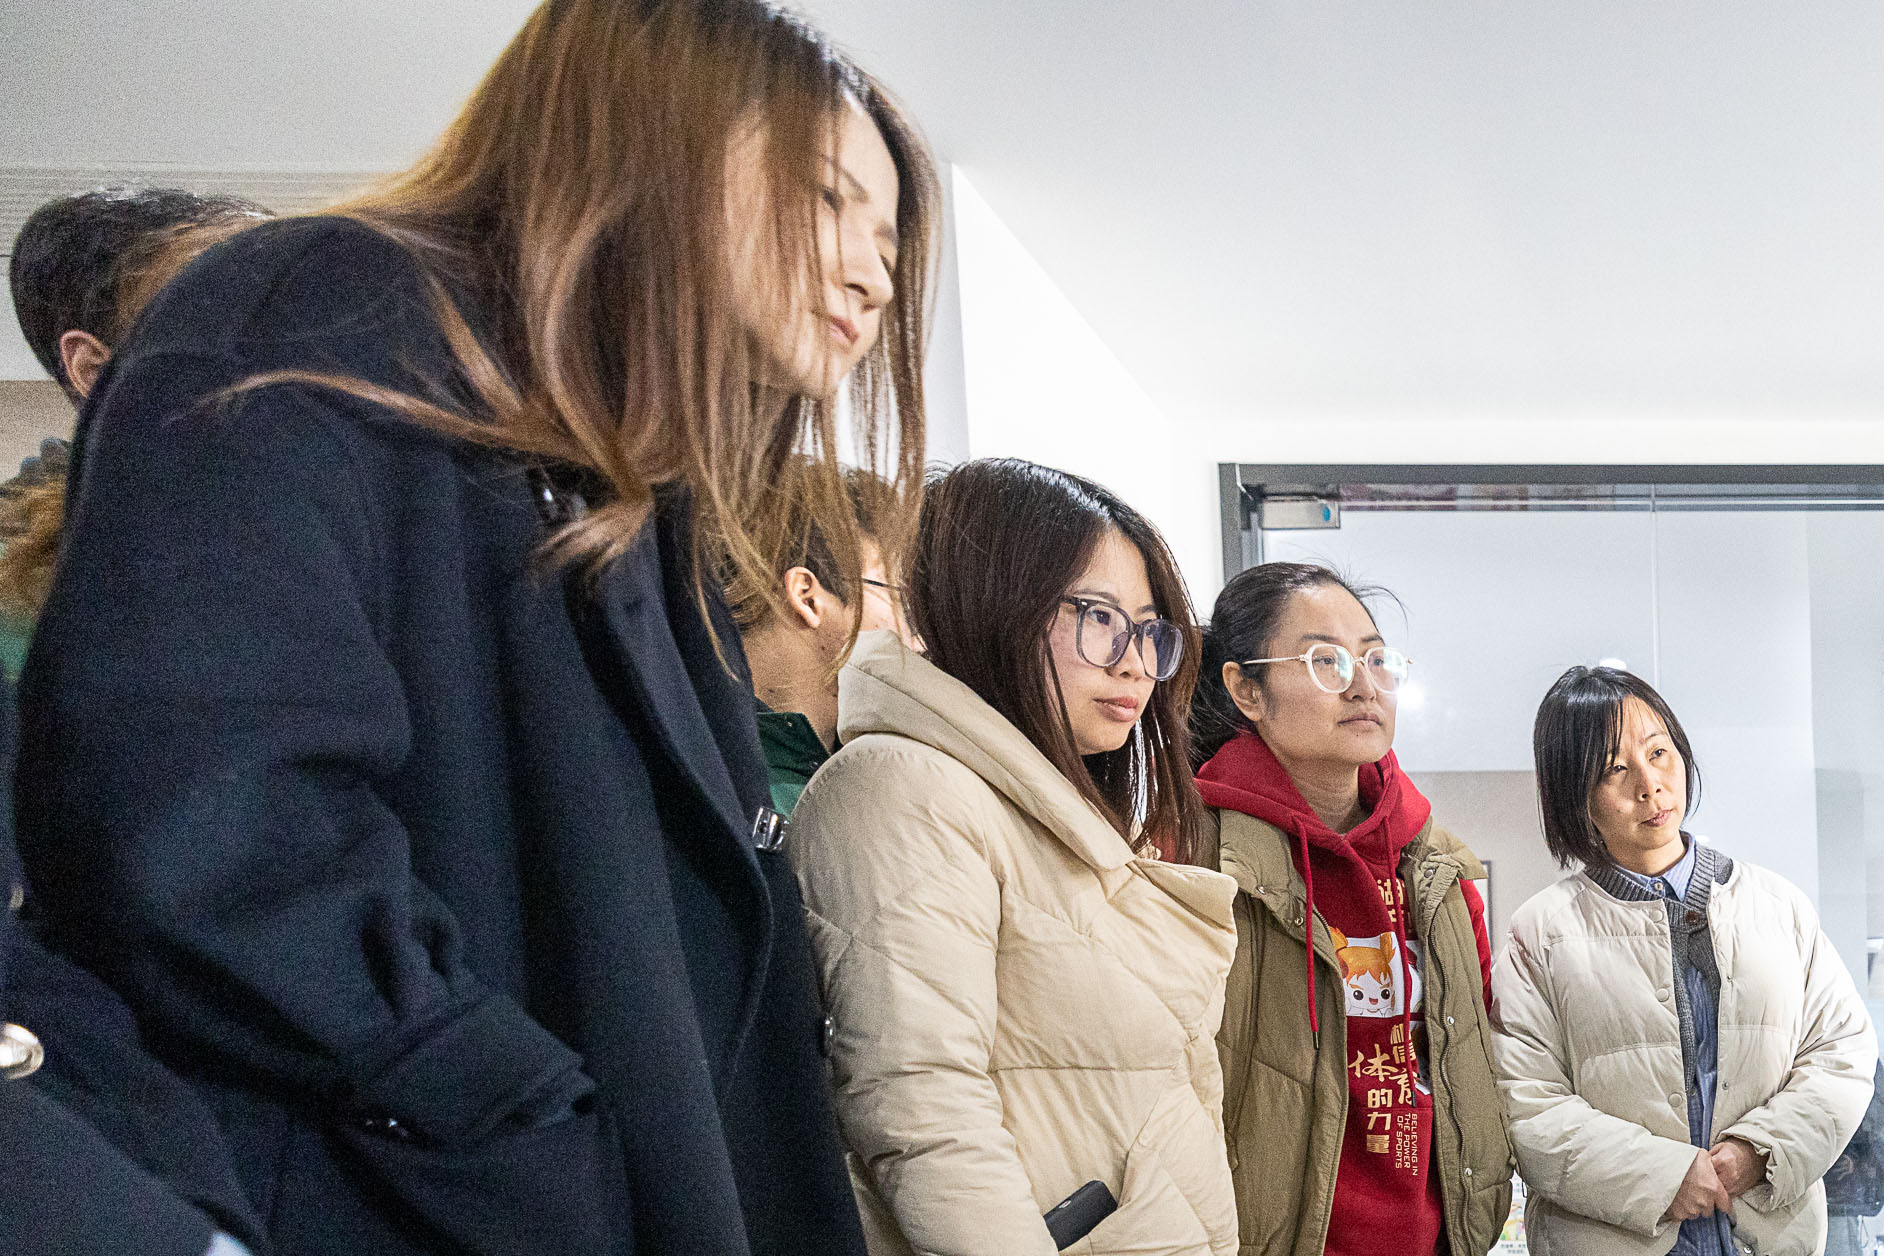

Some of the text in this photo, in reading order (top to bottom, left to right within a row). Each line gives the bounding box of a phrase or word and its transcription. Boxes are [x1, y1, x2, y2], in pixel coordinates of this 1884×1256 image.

[1366, 1088, 1393, 1154] 的力量
[1395, 1115, 1404, 1169] OF SPORTS
[1403, 1112, 1411, 1169] THE POWER
[1412, 1165, 1418, 1176] IN
